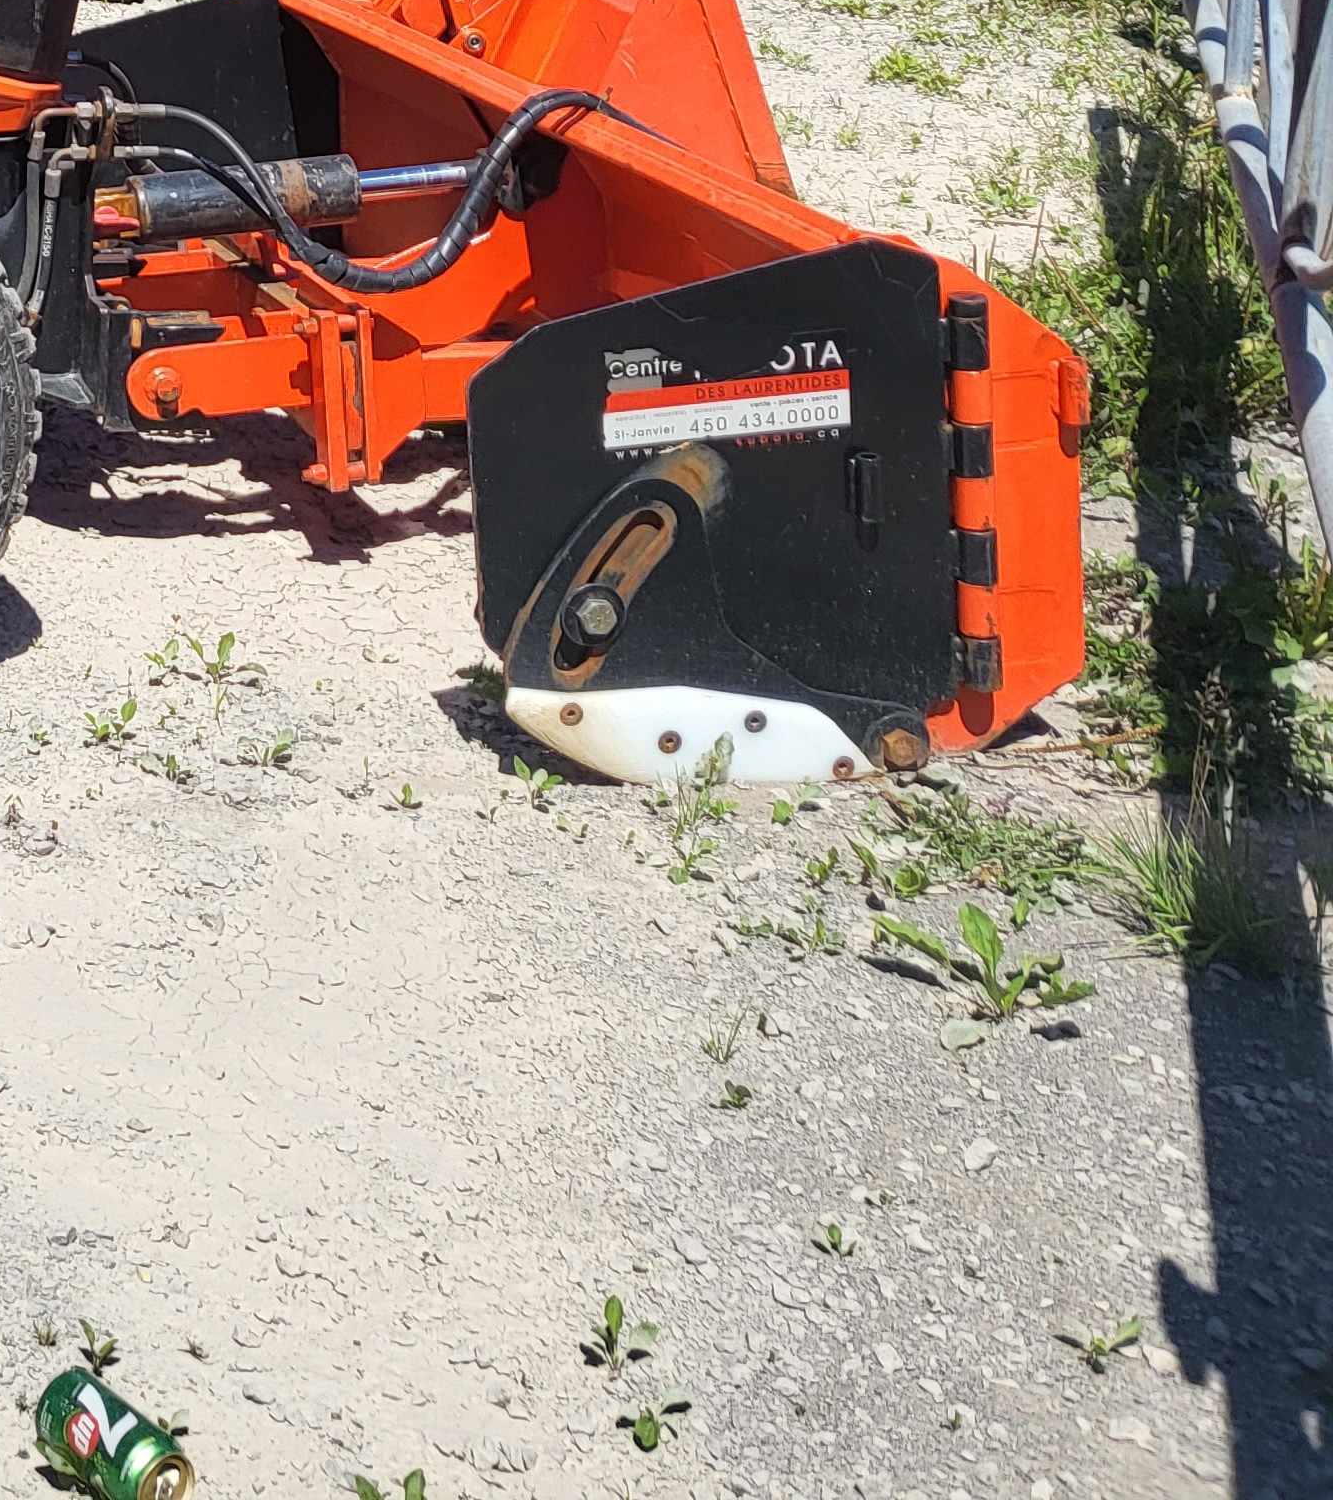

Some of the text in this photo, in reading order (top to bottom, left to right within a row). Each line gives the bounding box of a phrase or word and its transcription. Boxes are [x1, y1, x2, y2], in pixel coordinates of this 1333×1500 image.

[609, 339, 844, 378] Centre OTA
[695, 374, 842, 401] DES LAURENTIDES
[811, 395, 838, 403] service
[689, 416, 728, 434] 450
[738, 405, 839, 429] 434.0000
